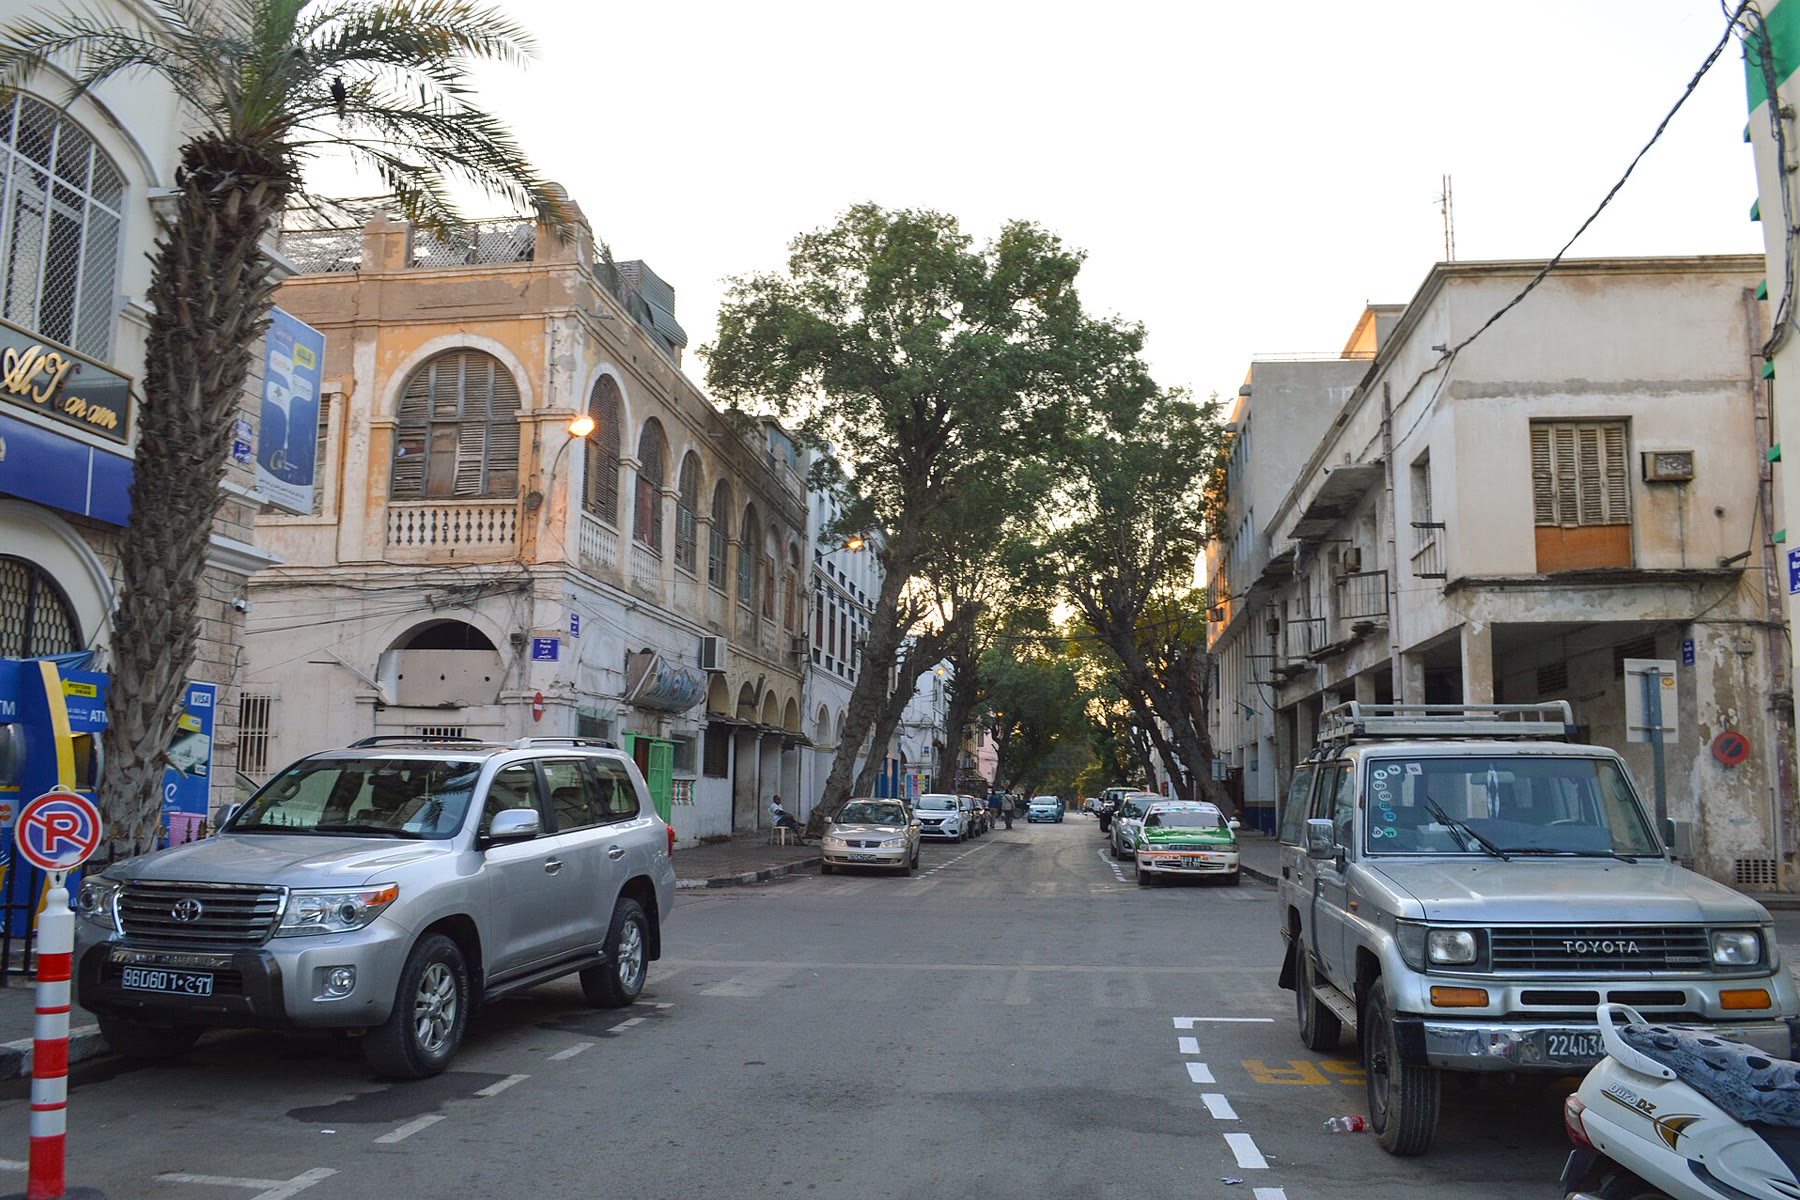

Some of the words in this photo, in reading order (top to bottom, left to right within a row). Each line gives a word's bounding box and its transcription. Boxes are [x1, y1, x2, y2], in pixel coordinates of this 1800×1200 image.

[193, 694, 209, 704] VISA
[0, 700, 16, 715] M
[1563, 941, 1640, 954] TOYOTA
[124, 969, 167, 989] 96D60
[1608, 1082, 1638, 1105] Duro
[1635, 1098, 1657, 1114] DZ
